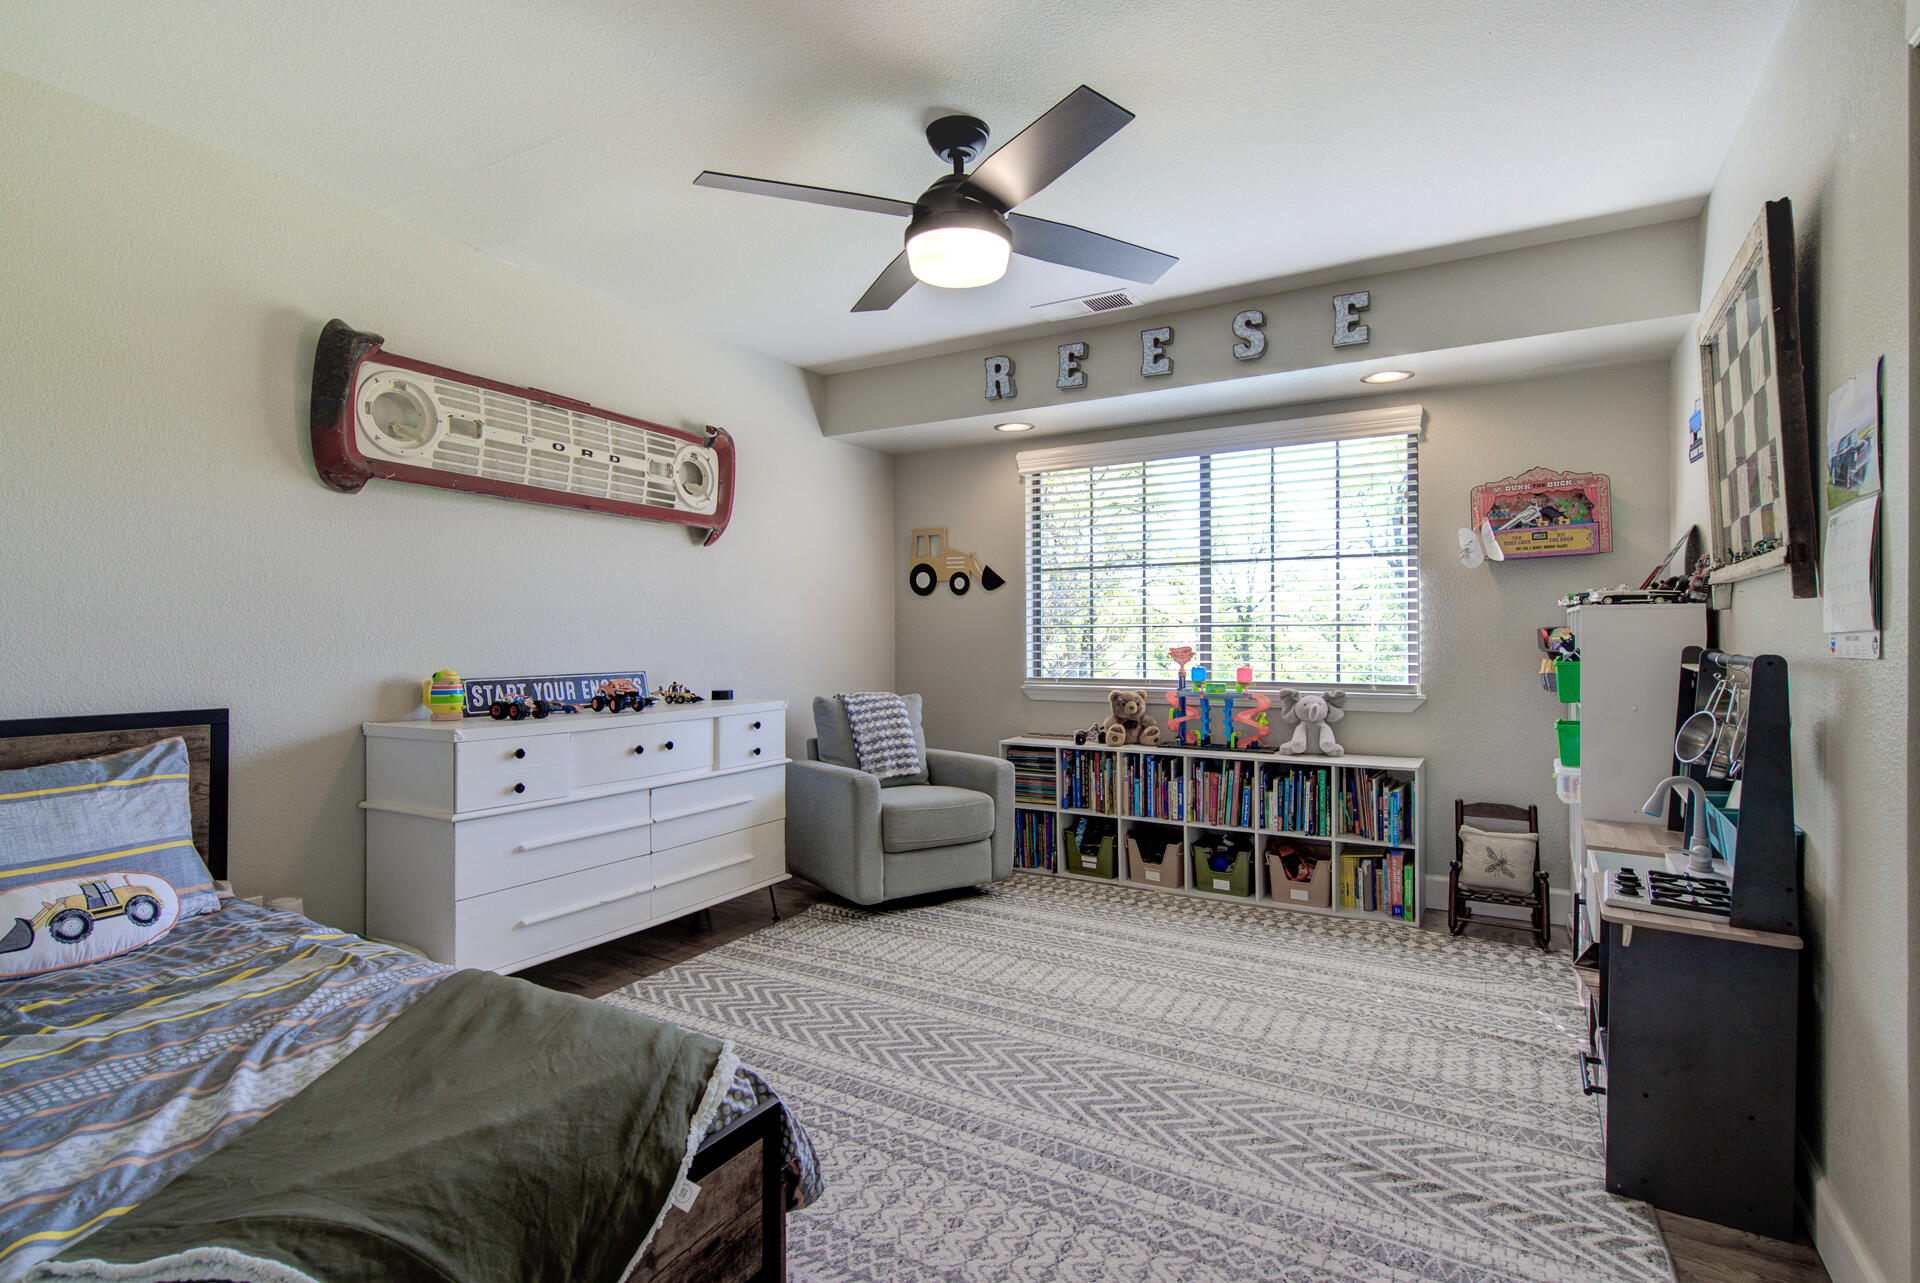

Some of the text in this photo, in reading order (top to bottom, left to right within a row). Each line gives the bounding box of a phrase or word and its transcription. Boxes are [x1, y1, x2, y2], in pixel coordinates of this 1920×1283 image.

[985, 291, 1371, 401] REESE
[1505, 483, 1531, 492] DUNK
[1547, 480, 1573, 488] DUCK
[533, 680, 577, 703] YOUR
